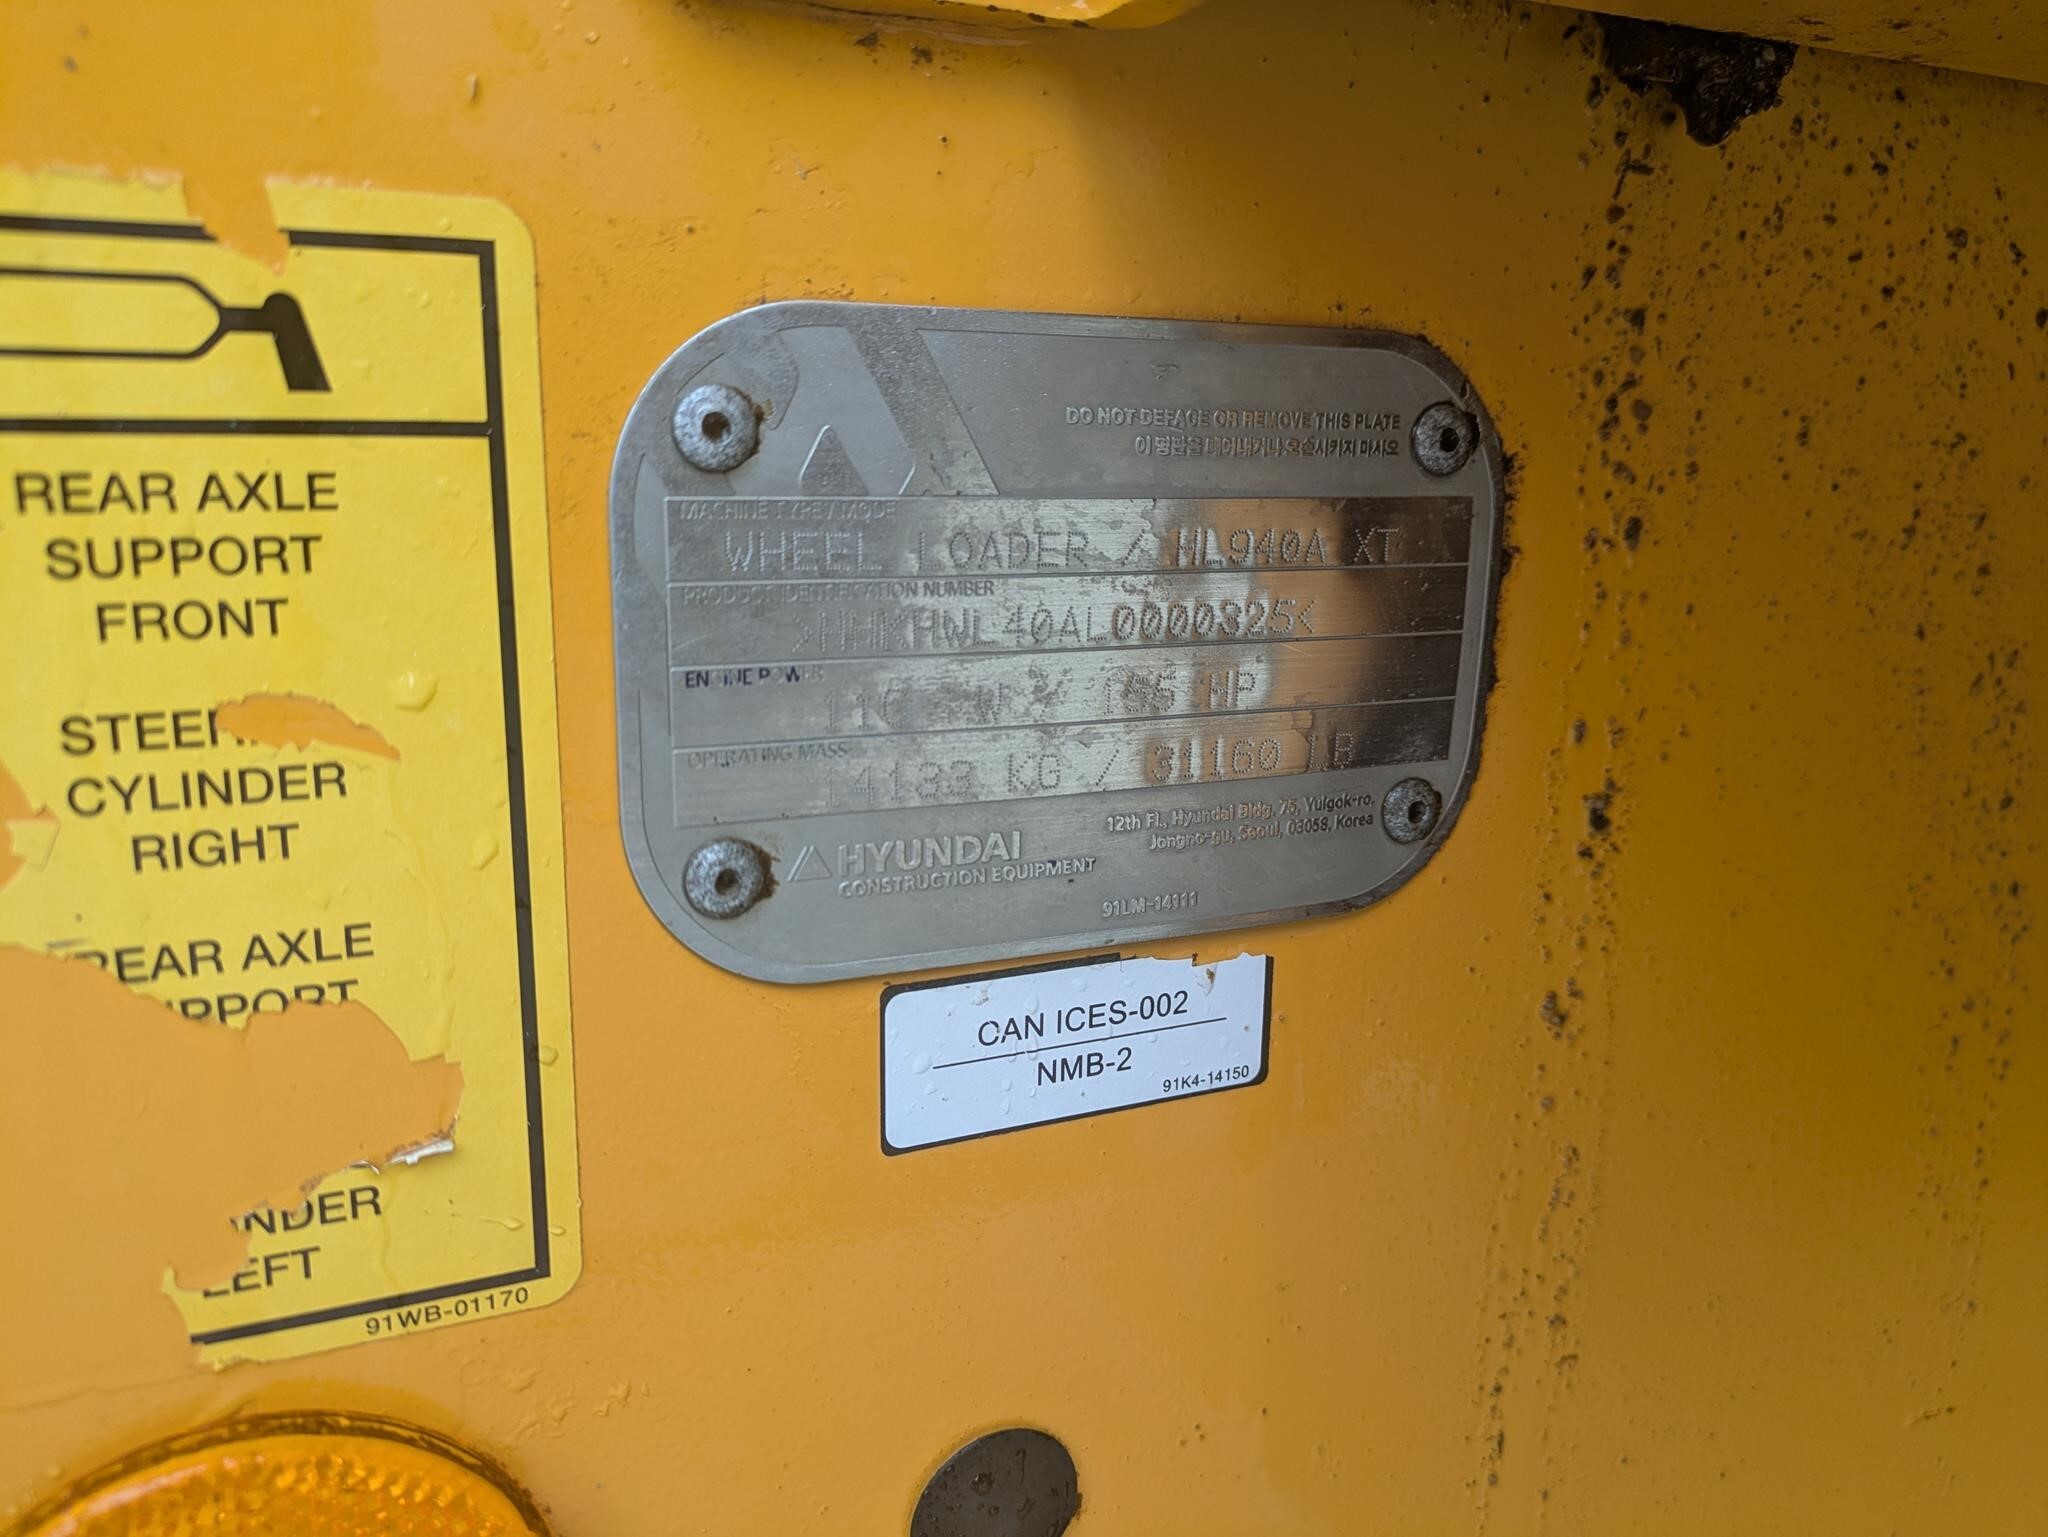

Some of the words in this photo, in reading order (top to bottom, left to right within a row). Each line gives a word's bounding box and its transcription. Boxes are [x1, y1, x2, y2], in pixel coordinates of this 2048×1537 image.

[1066, 406, 1094, 426] DO
[1098, 407, 1137, 427] NOT
[1139, 408, 1210, 429] DEFACE
[1213, 409, 1239, 429] OR
[1242, 409, 1312, 430] REMOVE
[1314, 411, 1353, 431] THIS
[1355, 412, 1400, 432] PLATE
[1135, 435, 1152, 456] 이
[15, 471, 178, 515] REAR
[196, 471, 339, 512] AXLE
[679, 501, 768, 520] MACHINE
[46, 534, 323, 580] SUPPORT
[725, 530, 883, 573] WHEEL
[917, 530, 1090, 572] LOADER
[1121, 529, 1147, 567] /
[1175, 527, 1328, 567] HL940A
[1352, 527, 1400, 565] XT
[922, 579, 995, 598] NUMBER
[96, 596, 289, 642] FRONT
[685, 666, 753, 689] ENGINE
[758, 664, 825, 687] POWER
[1207, 670, 1256, 708] HP
[687, 746, 793, 770] OPERATING
[798, 741, 849, 761] MASS
[1008, 752, 1061, 794] KG
[1096, 749, 1119, 786] /
[1151, 739, 1282, 782] 31160
[1305, 731, 1355, 770] LB
[66, 760, 347, 817] CYLINDER
[1106, 813, 1142, 833] 12th
[1171, 804, 1236, 828] Hyundai
[1335, 812, 1375, 831] Korea
[132, 823, 300, 873] RIGHT
[837, 831, 1022, 877] HYUNDAI
[837, 867, 986, 899] CONSTRUCTION
[990, 857, 1096, 884] EQUIPMENT
[242, 921, 375, 972] AXLE
[977, 1012, 1045, 1047] CAN
[1056, 990, 1189, 1034] ICES-002
[1037, 1046, 1133, 1087] NMB-2
[1162, 1064, 1250, 1094] 91K4-14150
[365, 1285, 530, 1336] 91WB-01170
